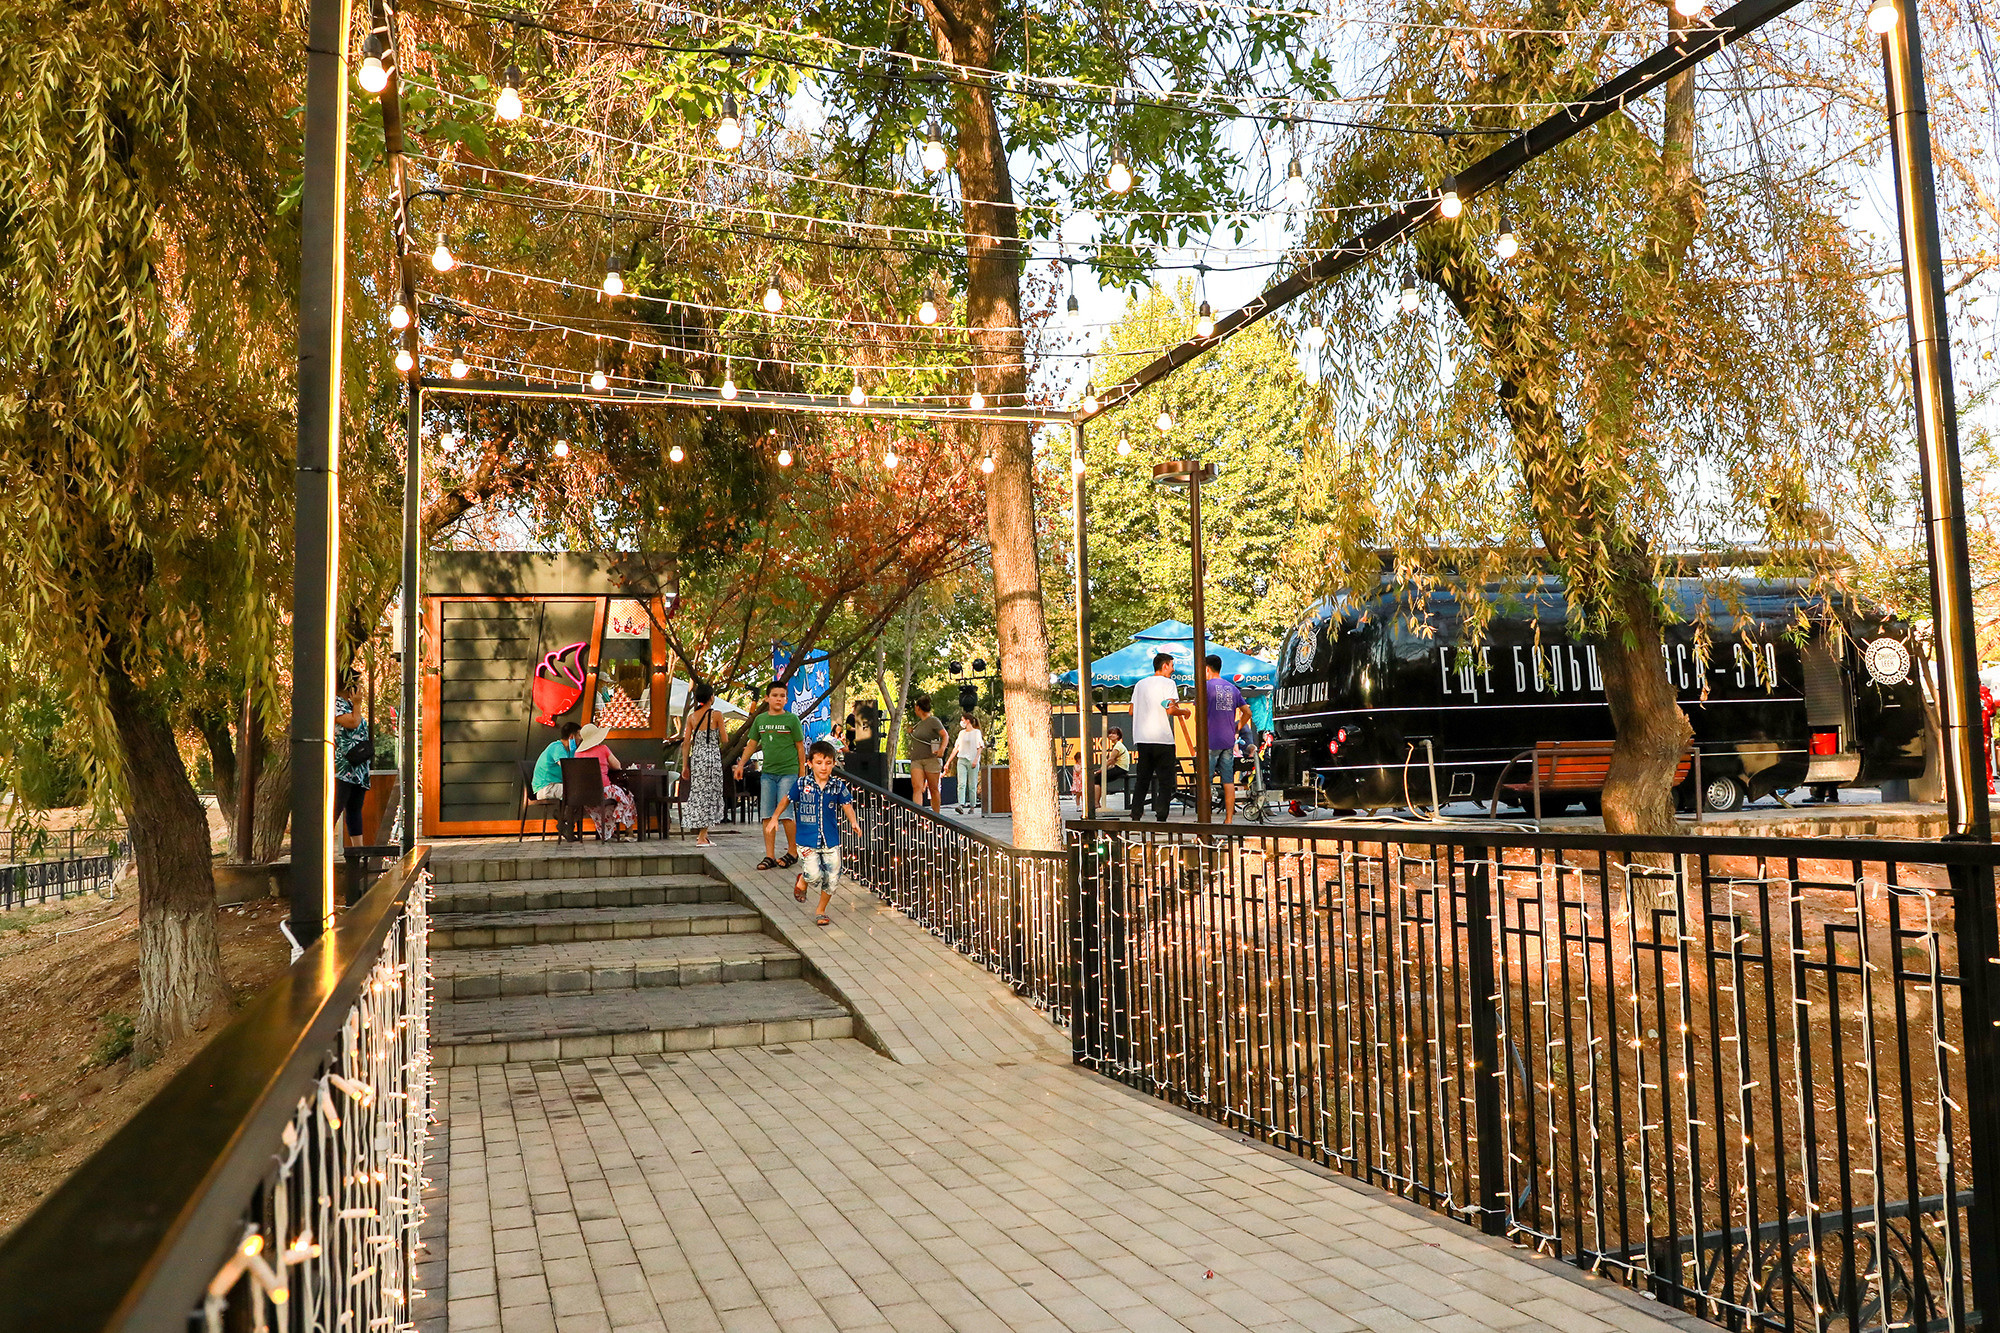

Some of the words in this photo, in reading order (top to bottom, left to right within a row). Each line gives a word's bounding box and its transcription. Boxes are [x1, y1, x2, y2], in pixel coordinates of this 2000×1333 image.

[1096, 673, 1120, 682] pepsi
[1246, 674, 1270, 683] pepsi
[1440, 646, 1495, 703] ЕЩЕ
[1513, 645, 1605, 693] БОЛЬШ
[1661, 643, 1706, 689] ЯСА
[1733, 643, 1778, 688] ЭТО
[800, 792, 816, 803] ENJOY
[800, 803, 816, 814] EVERY
